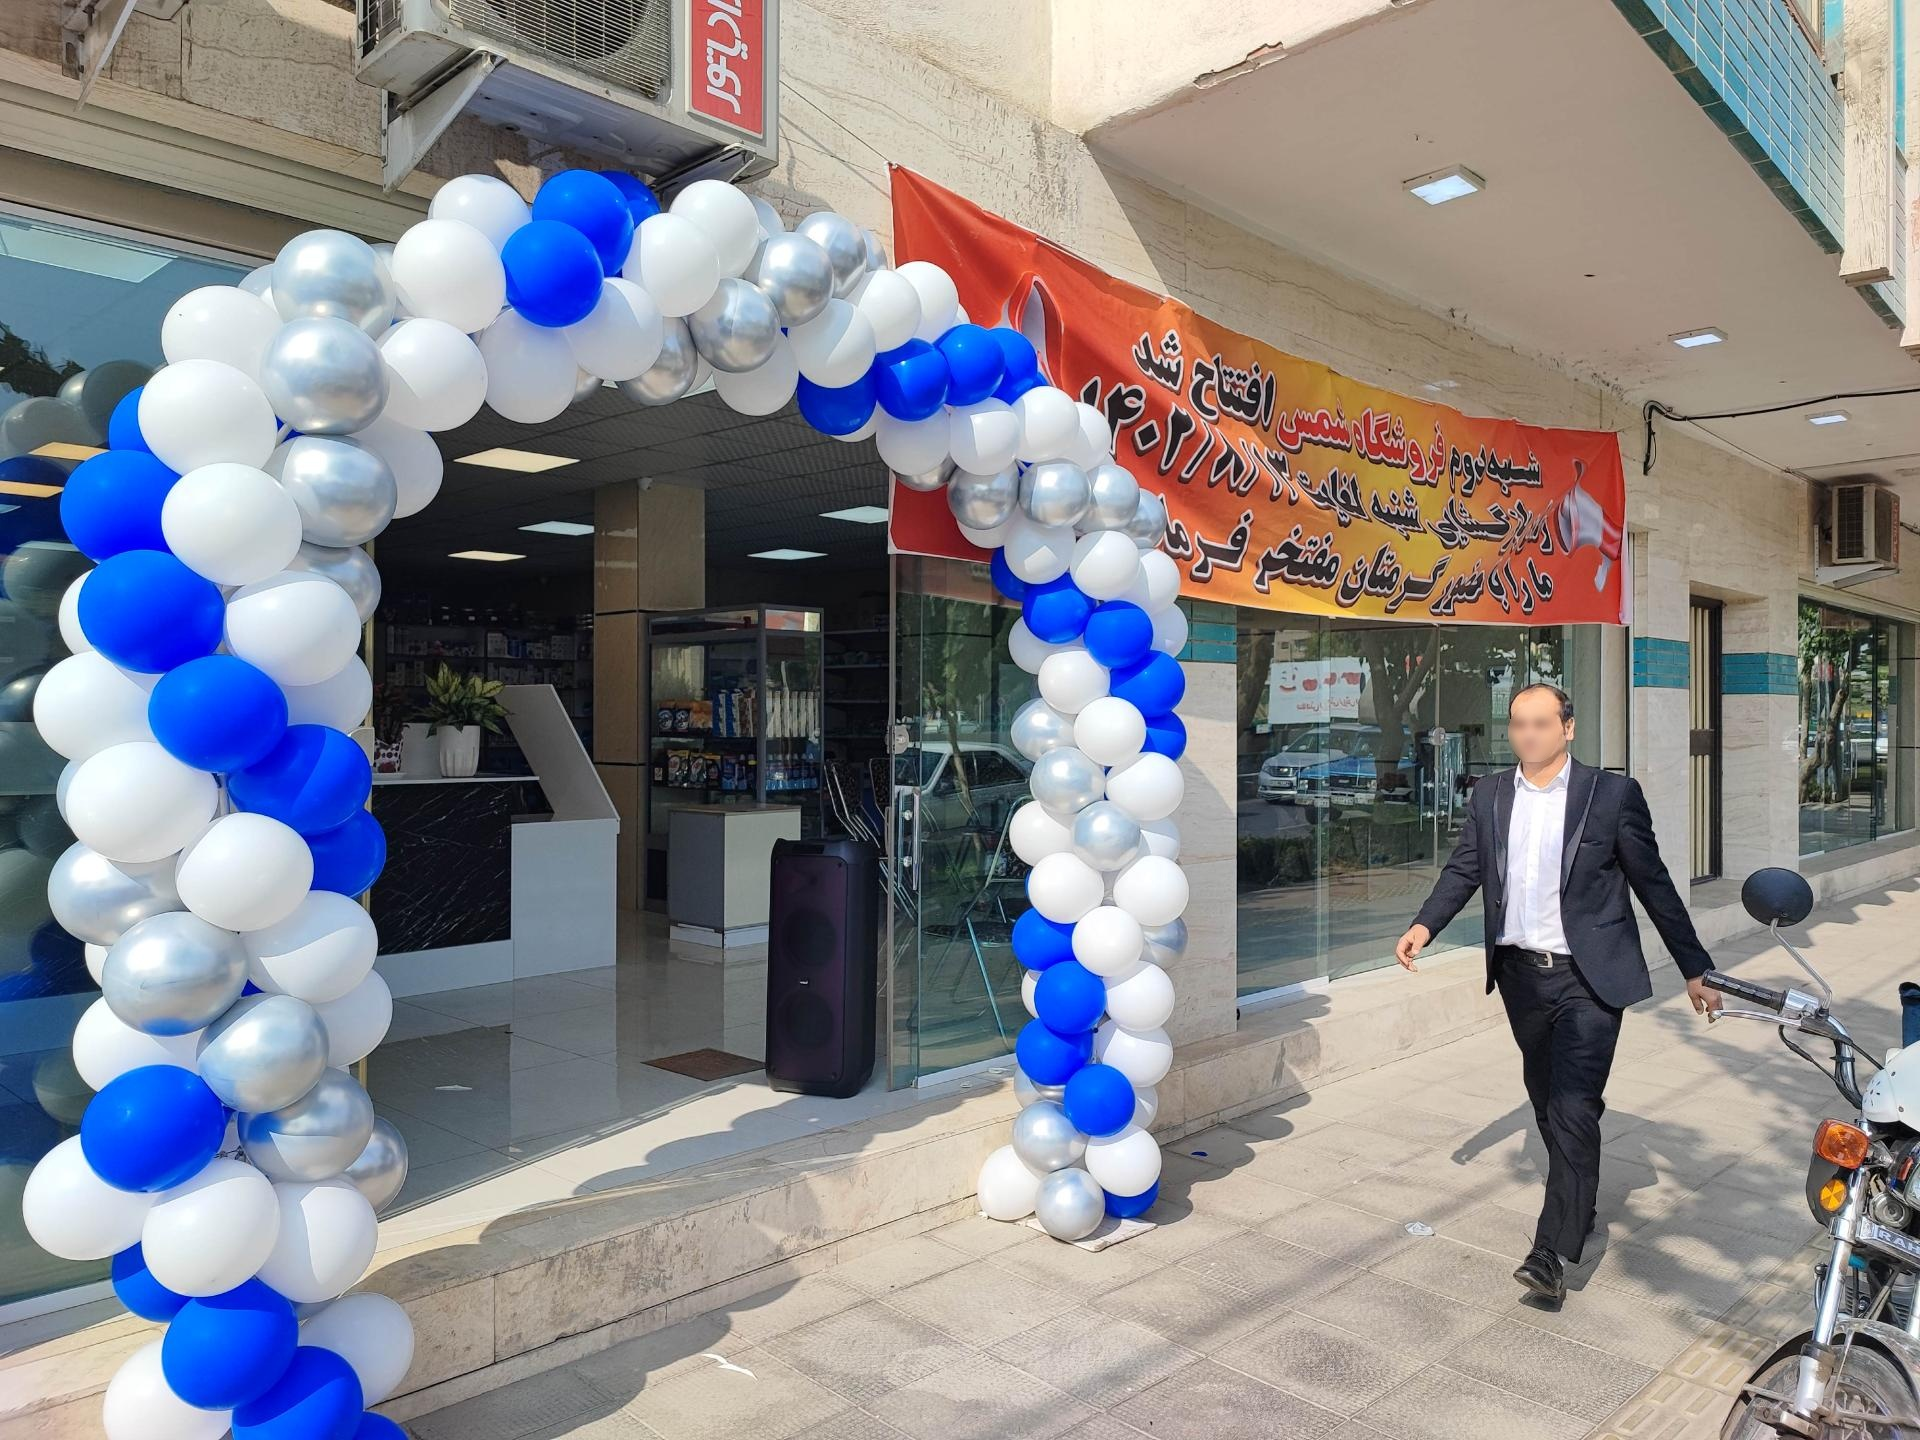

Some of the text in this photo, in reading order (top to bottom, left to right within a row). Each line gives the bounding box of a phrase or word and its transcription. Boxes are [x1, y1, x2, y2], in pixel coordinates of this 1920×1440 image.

[706, 0, 749, 114] ادیاتور
[1132, 329, 1184, 394] شد
[1188, 352, 1276, 430] افتتاح
[1276, 397, 1351, 453] شمس
[1351, 407, 1446, 486] فروشگاه
[1296, 466, 1372, 528] لغایت
[1450, 444, 1488, 496] دوم
[1158, 492, 1254, 583] فرما
[1371, 487, 1427, 540] شنبه
[1254, 523, 1342, 594] مفتخر
[1503, 557, 1535, 614] را
[1526, 557, 1554, 600] ما
